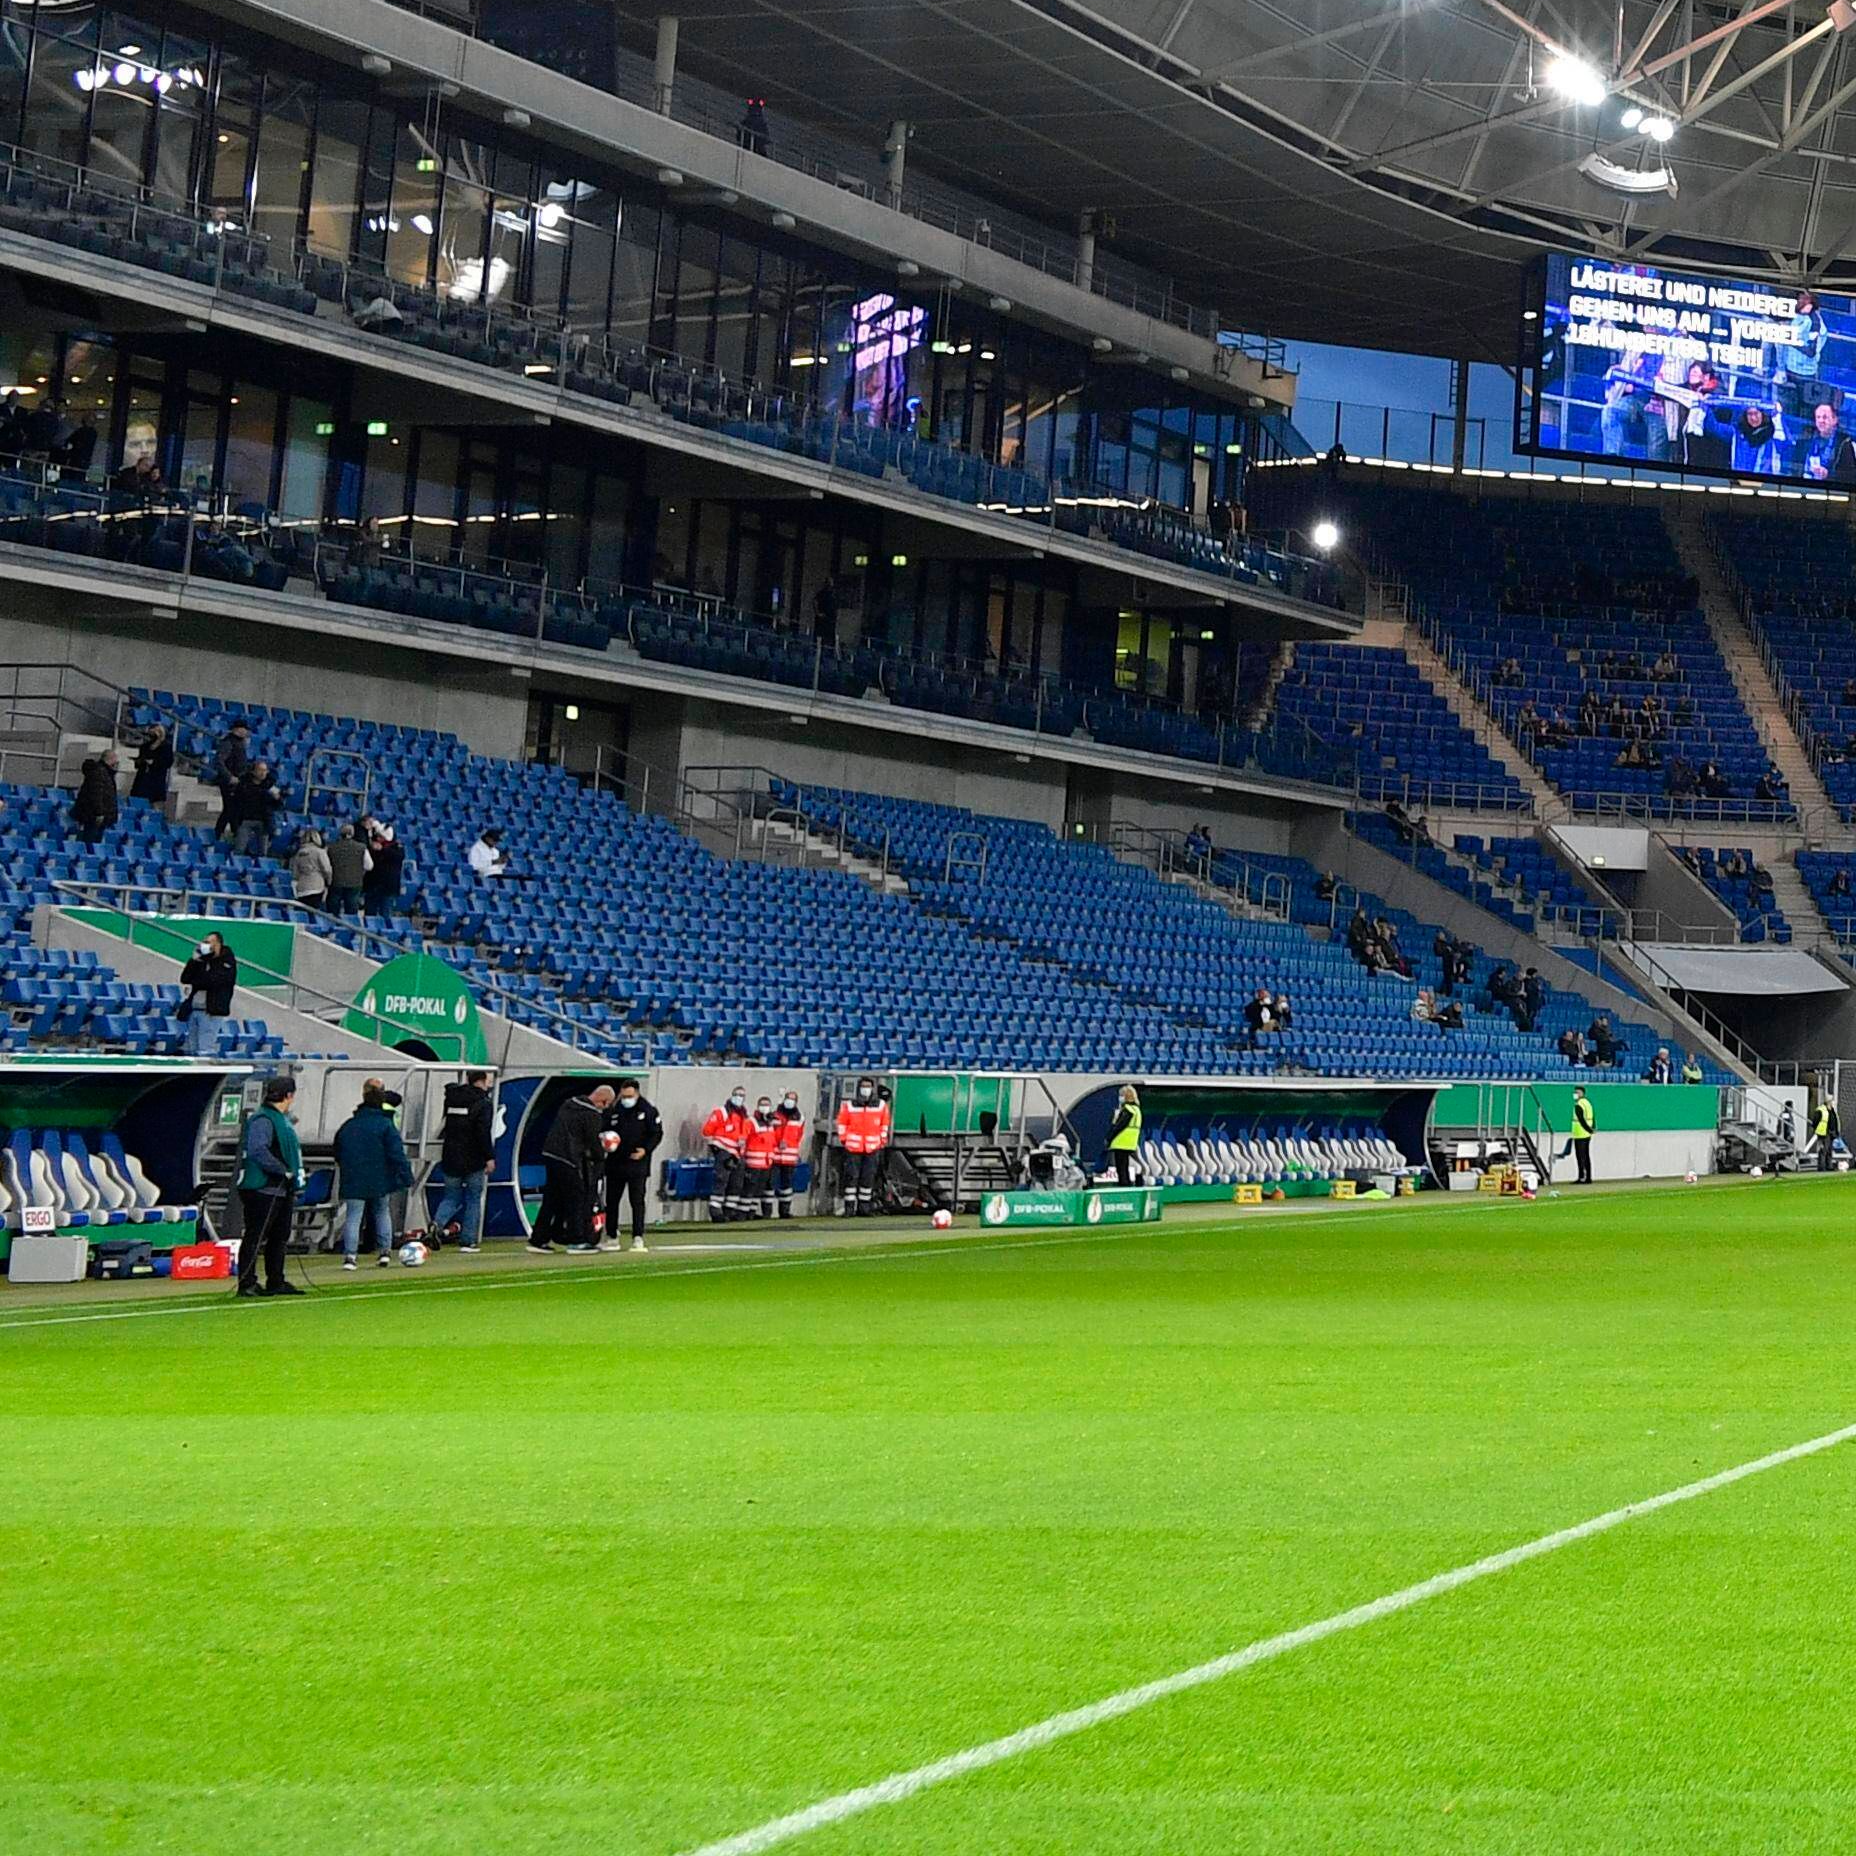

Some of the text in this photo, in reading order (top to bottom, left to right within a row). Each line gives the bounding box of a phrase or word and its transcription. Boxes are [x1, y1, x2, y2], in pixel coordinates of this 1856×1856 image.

[1571, 266, 1798, 319] LÄSTEREI UND NEIDEREI
[1569, 295, 1633, 323] GEHEN
[1636, 305, 1677, 329] UNS
[1678, 311, 1711, 334] AM
[385, 994, 446, 1016] DFB-POKAL
[26, 1211, 50, 1227] ERGO
